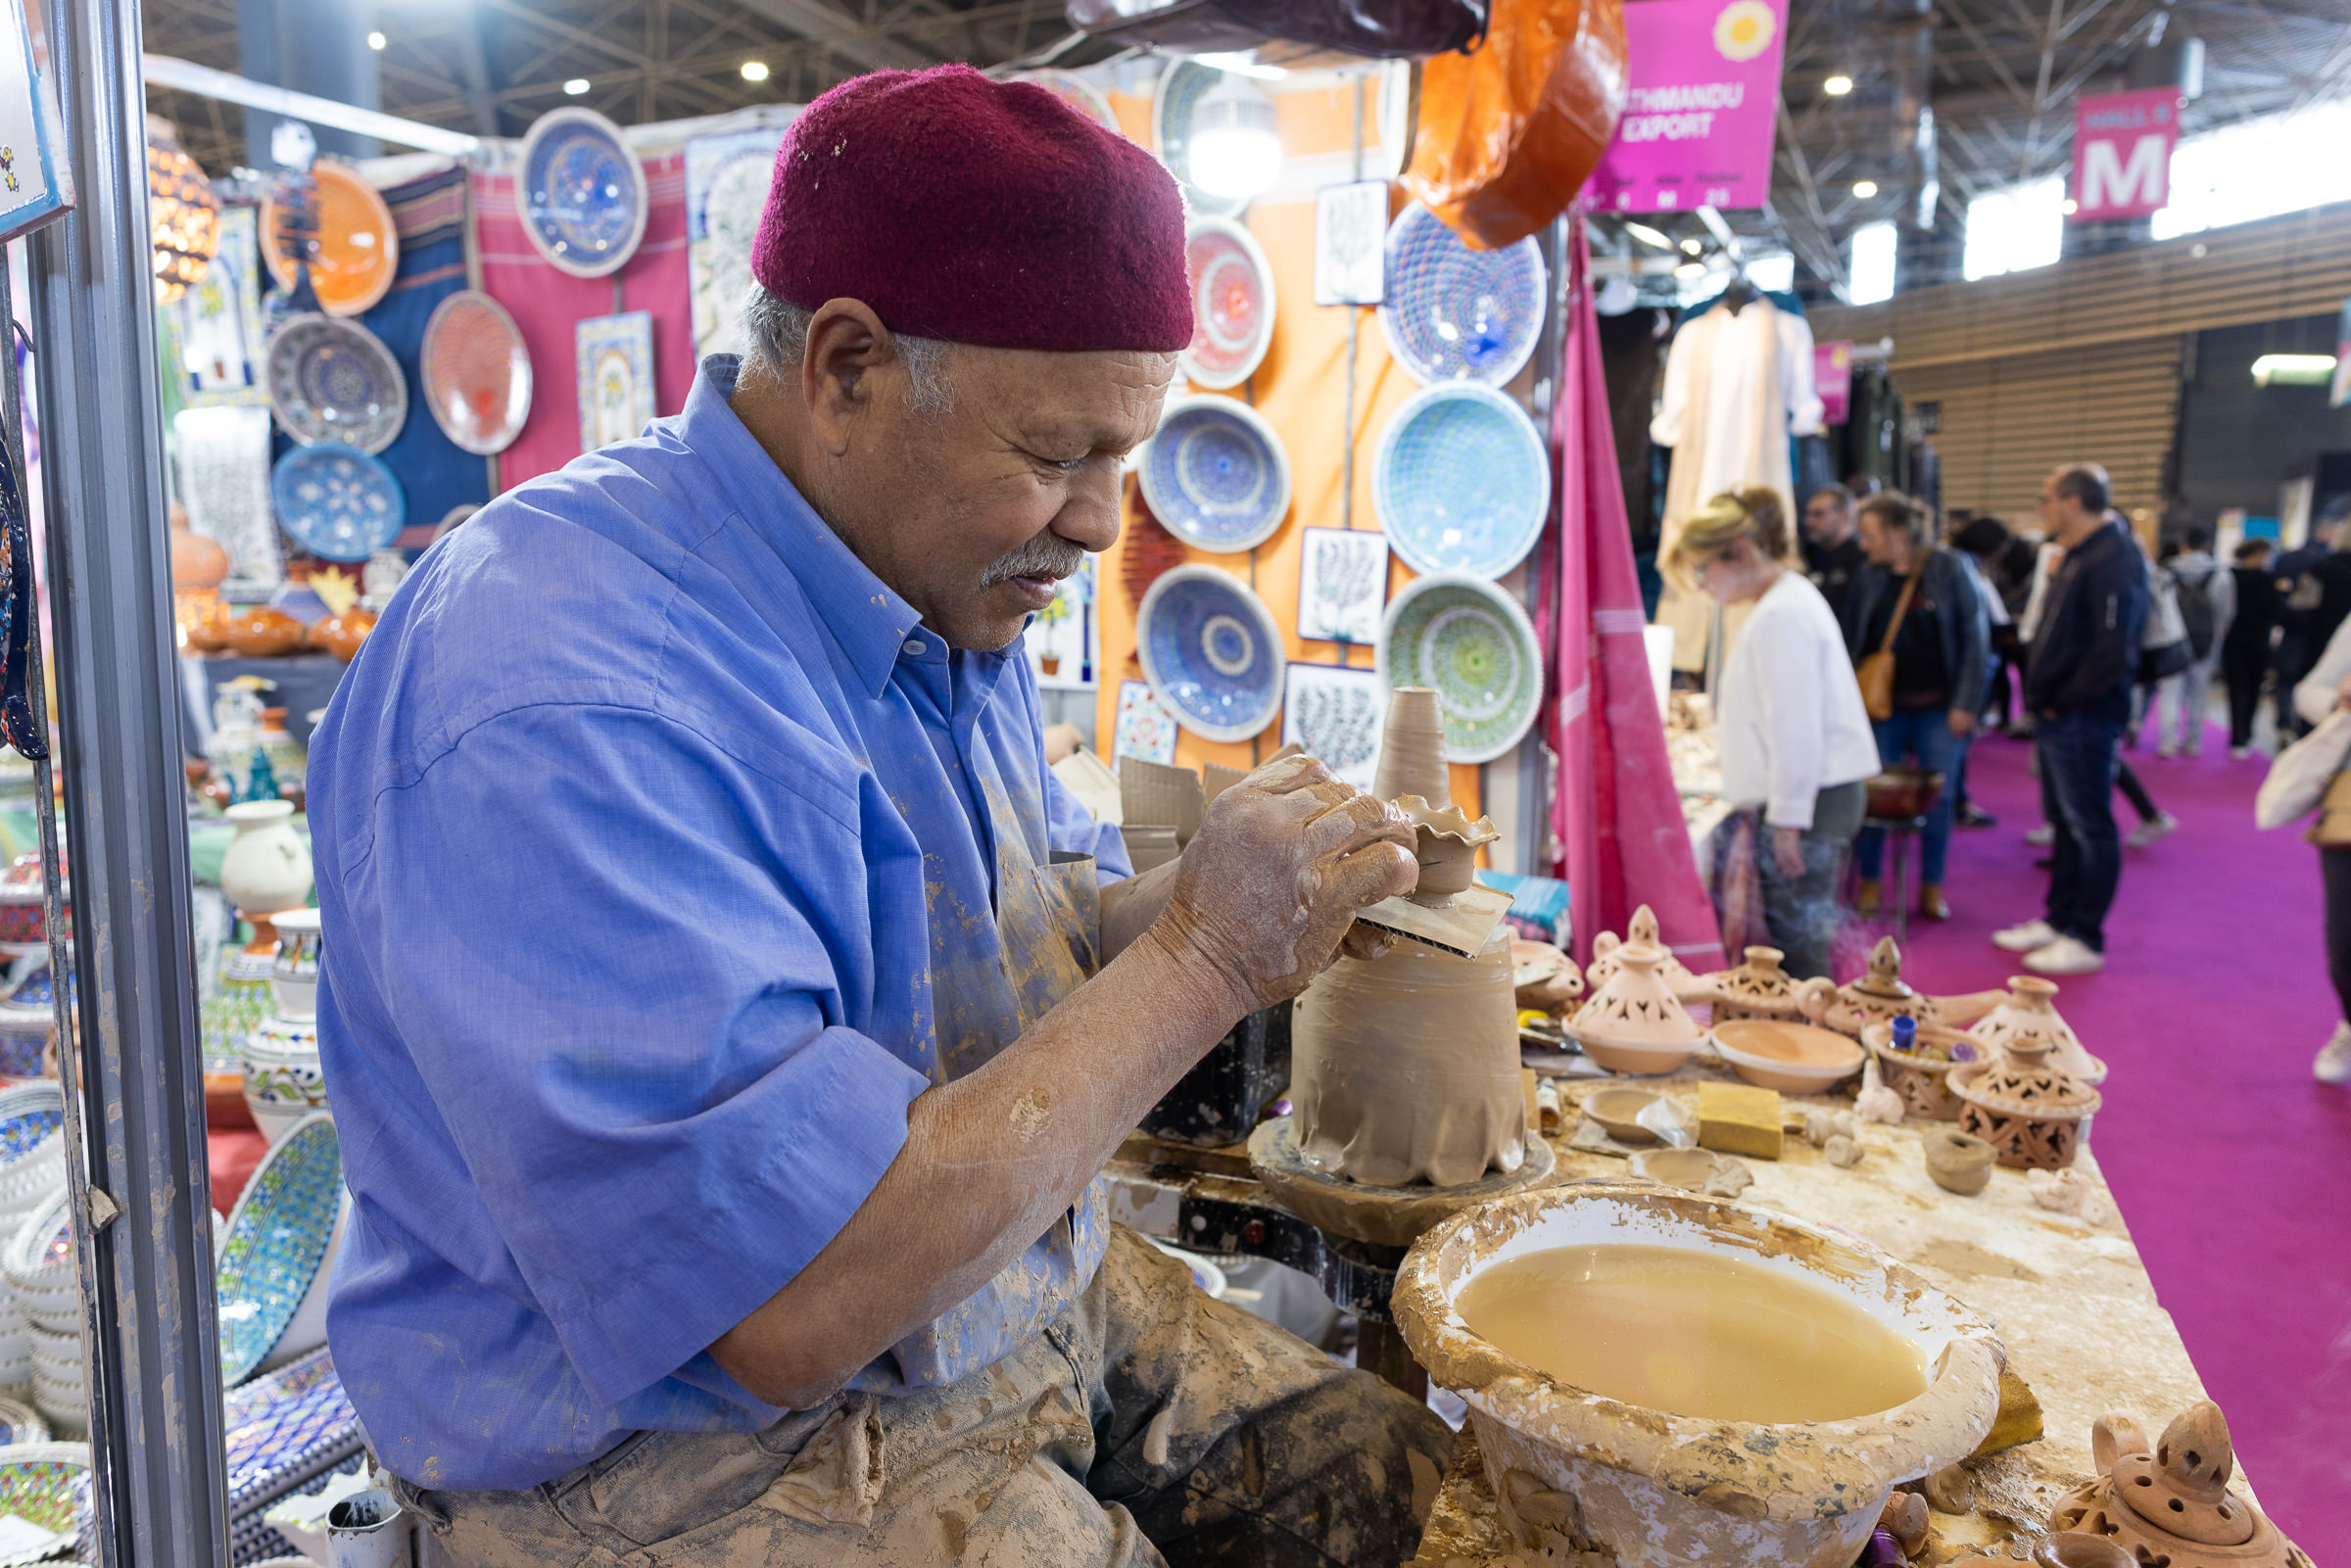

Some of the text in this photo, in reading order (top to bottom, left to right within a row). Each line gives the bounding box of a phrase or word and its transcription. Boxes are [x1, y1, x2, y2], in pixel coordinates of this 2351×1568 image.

[1624, 82, 1745, 114] THMANDU
[1621, 112, 1715, 143] EXPORT
[2081, 134, 2166, 210] M
